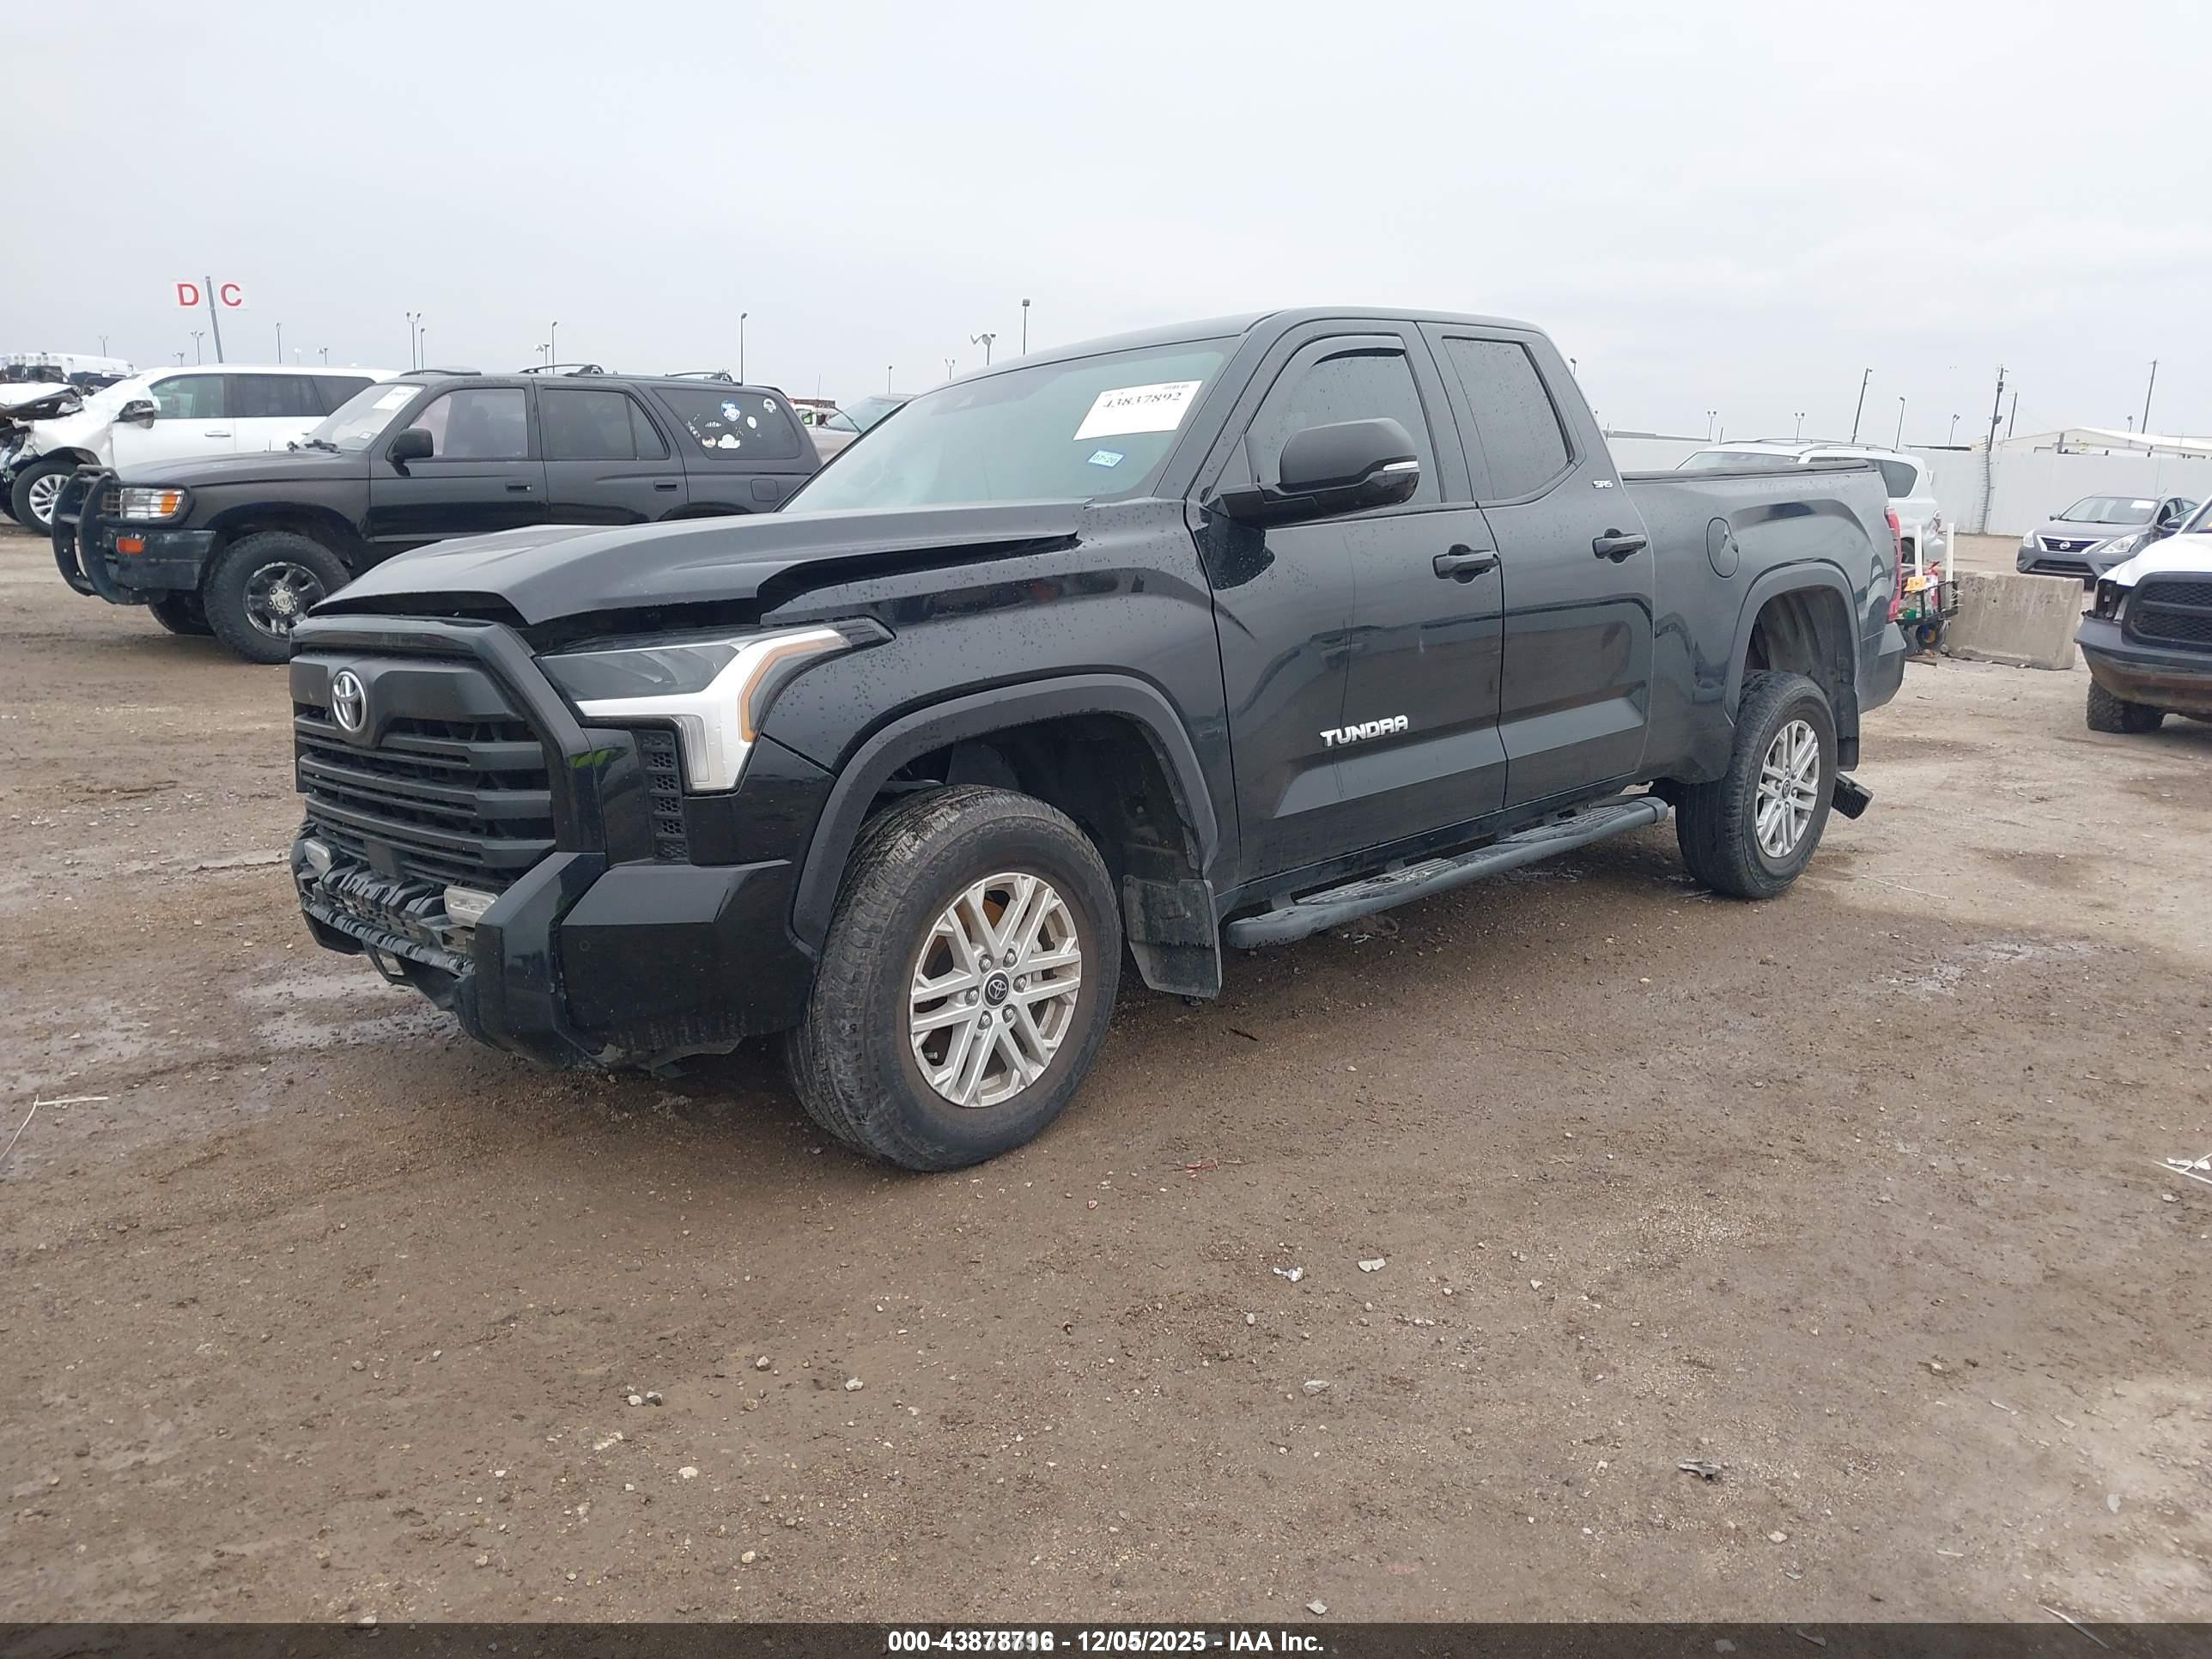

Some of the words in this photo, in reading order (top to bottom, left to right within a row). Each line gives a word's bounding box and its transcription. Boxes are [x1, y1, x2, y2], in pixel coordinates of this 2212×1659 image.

[177, 283, 199, 306] D
[221, 283, 242, 307] C
[1320, 715, 1408, 747] TUNDRA
